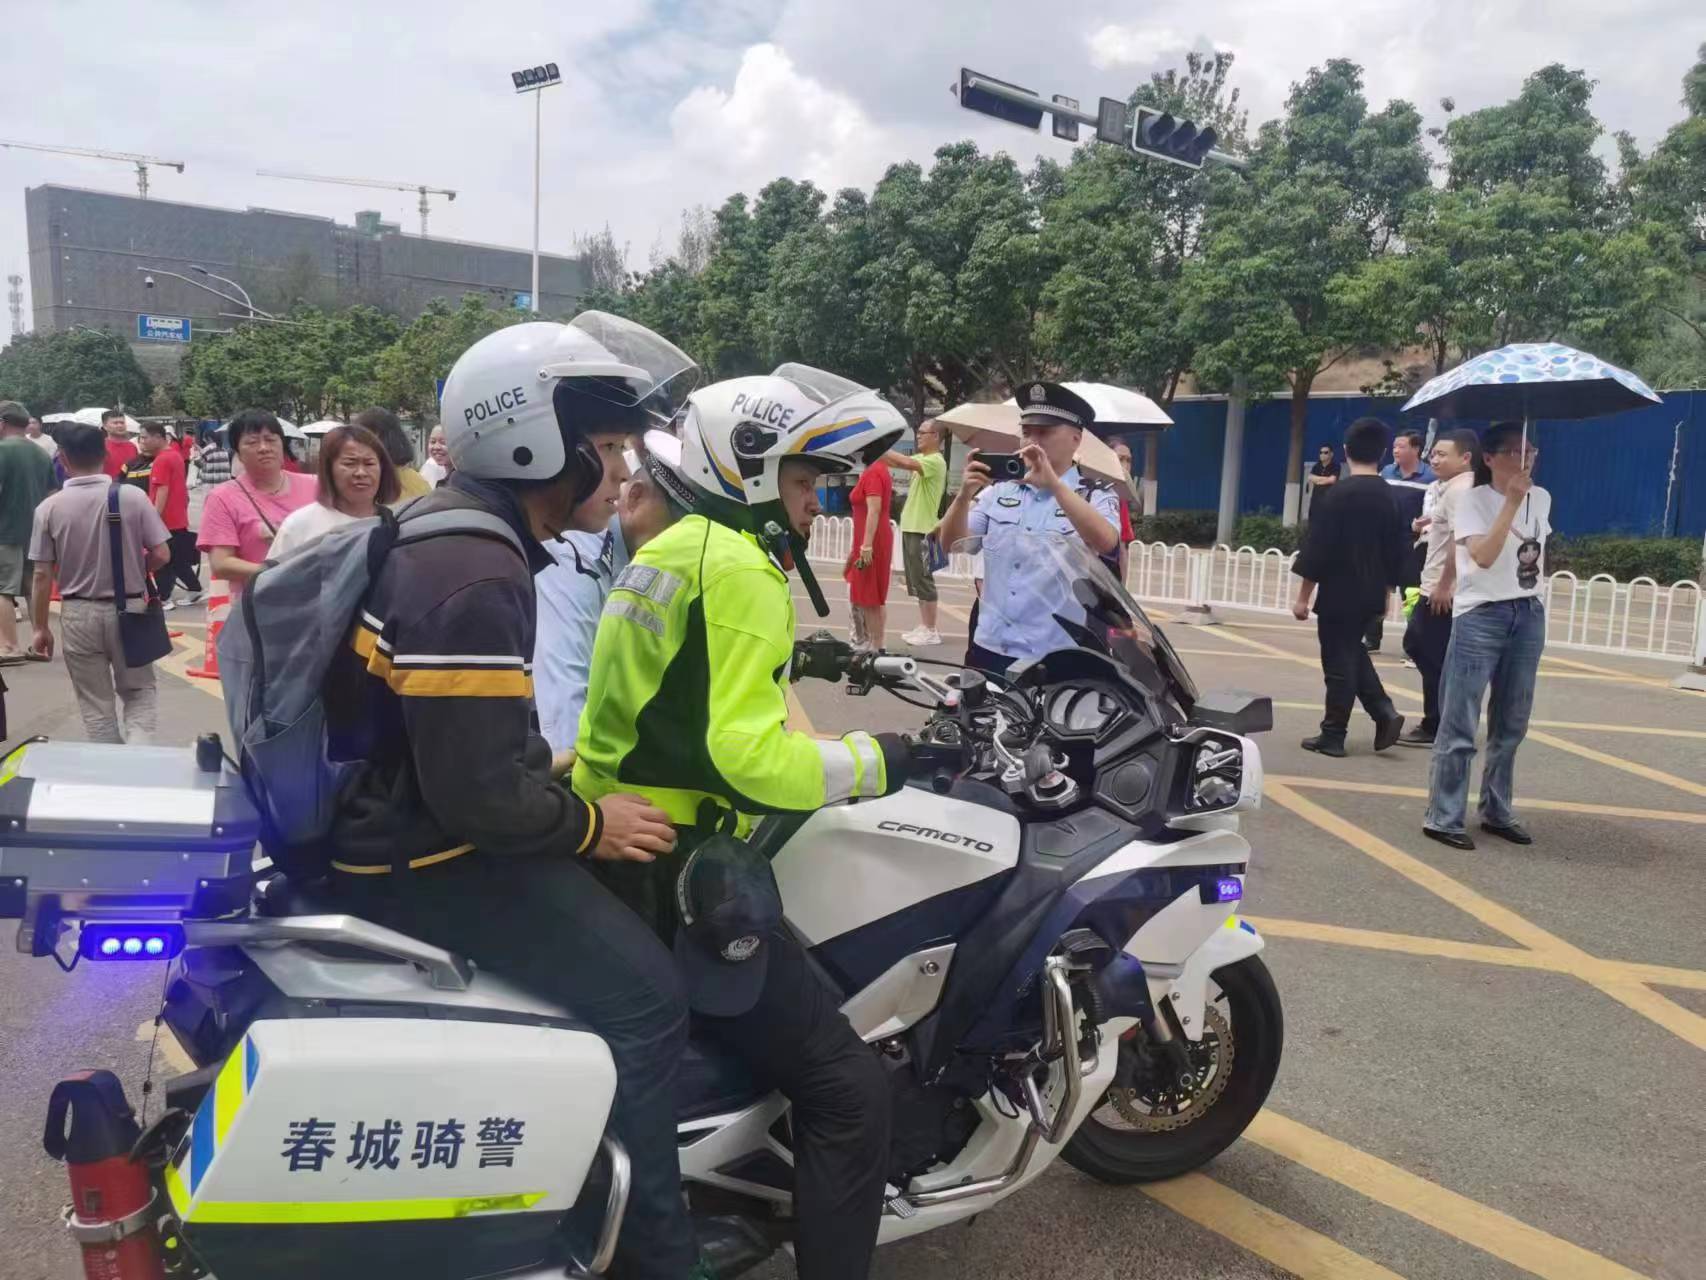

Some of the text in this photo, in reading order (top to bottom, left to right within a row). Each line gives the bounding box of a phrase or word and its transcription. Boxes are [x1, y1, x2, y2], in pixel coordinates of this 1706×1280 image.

[464, 386, 527, 427] POLICE
[731, 392, 795, 429] POLICE
[877, 820, 994, 853] CFMOTO
[280, 1117, 526, 1172] 春城骑警
